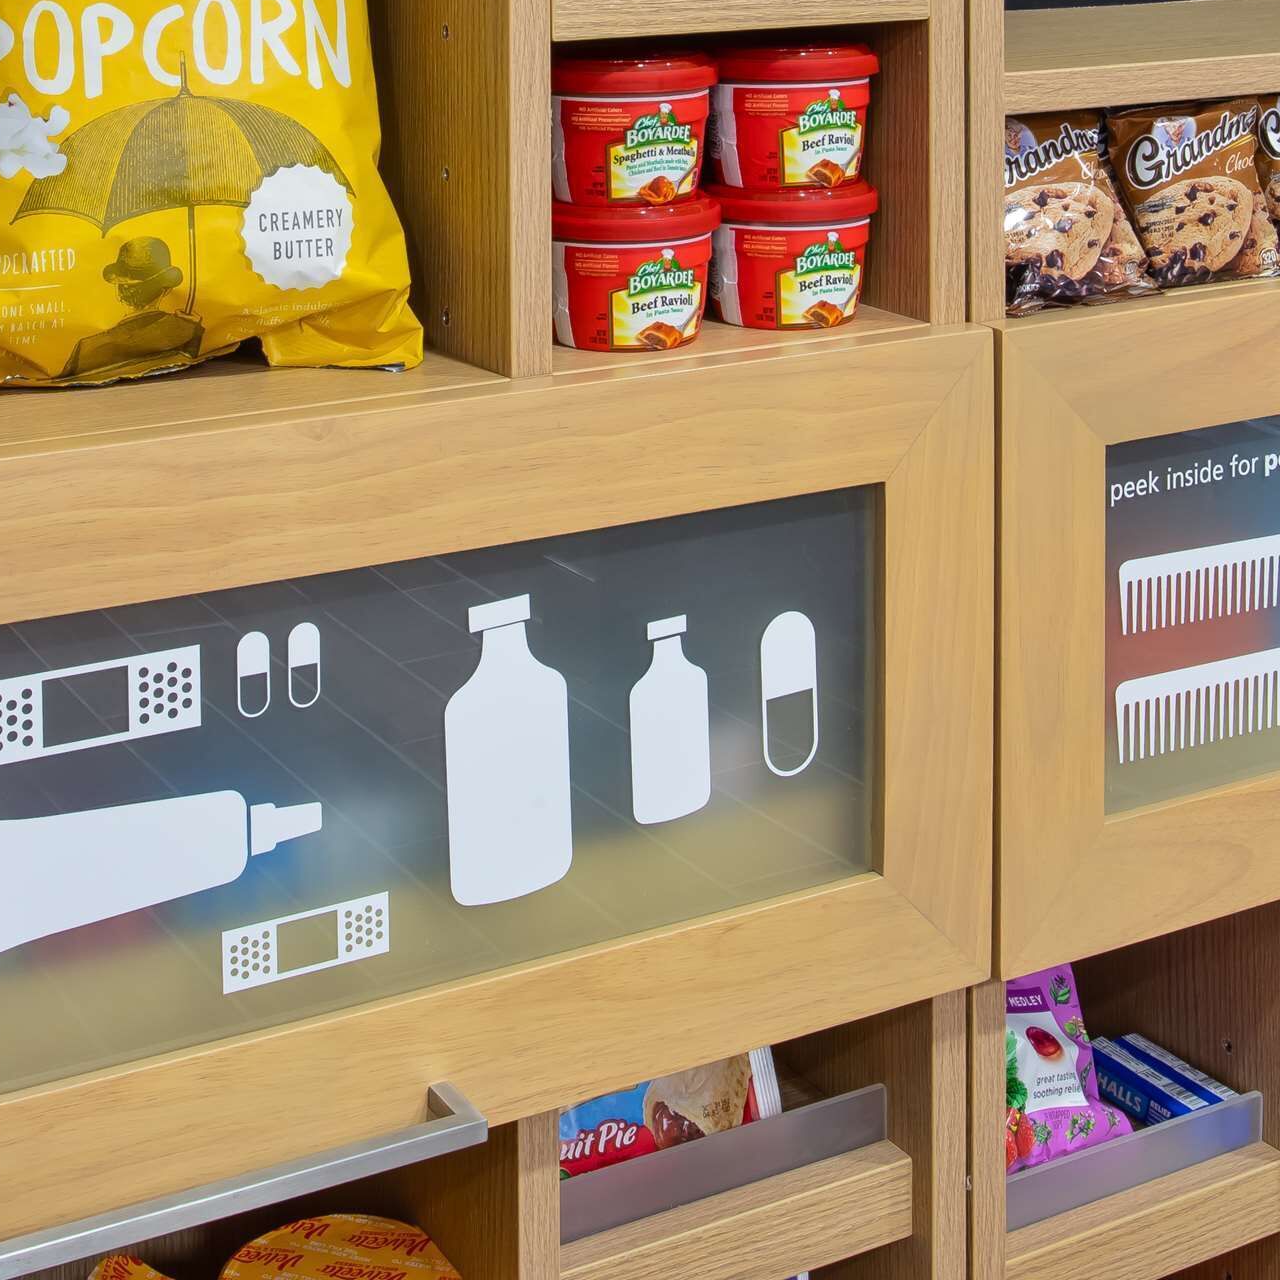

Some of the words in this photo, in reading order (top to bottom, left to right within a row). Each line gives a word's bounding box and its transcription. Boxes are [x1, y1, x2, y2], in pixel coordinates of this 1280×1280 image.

[798, 111, 857, 133] BOYARDEE
[626, 124, 691, 147] BOYARDEE
[801, 136, 826, 152] Beef
[827, 133, 854, 148] Ravioli
[613, 146, 656, 165] Spaghetti
[258, 208, 343, 233] CREAMERY
[273, 237, 335, 261] BUTTER
[796, 252, 855, 274] BOYARDEE
[629, 271, 694, 294] BOYARDEE
[798, 277, 822, 292] Beef
[824, 274, 853, 288] Ravioli
[632, 298, 659, 314] Beef
[661, 293, 693, 308] Ravioli
[1110, 470, 1160, 506] peek
[1166, 458, 1223, 491] inside
[1230, 453, 1258, 479] for
[1008, 994, 1042, 1007] MEDLEY
[1036, 1072, 1055, 1085] great
[1033, 1084, 1064, 1099] soothing
[1098, 1072, 1143, 1112] HALLS
[599, 1122, 637, 1153] Pie
